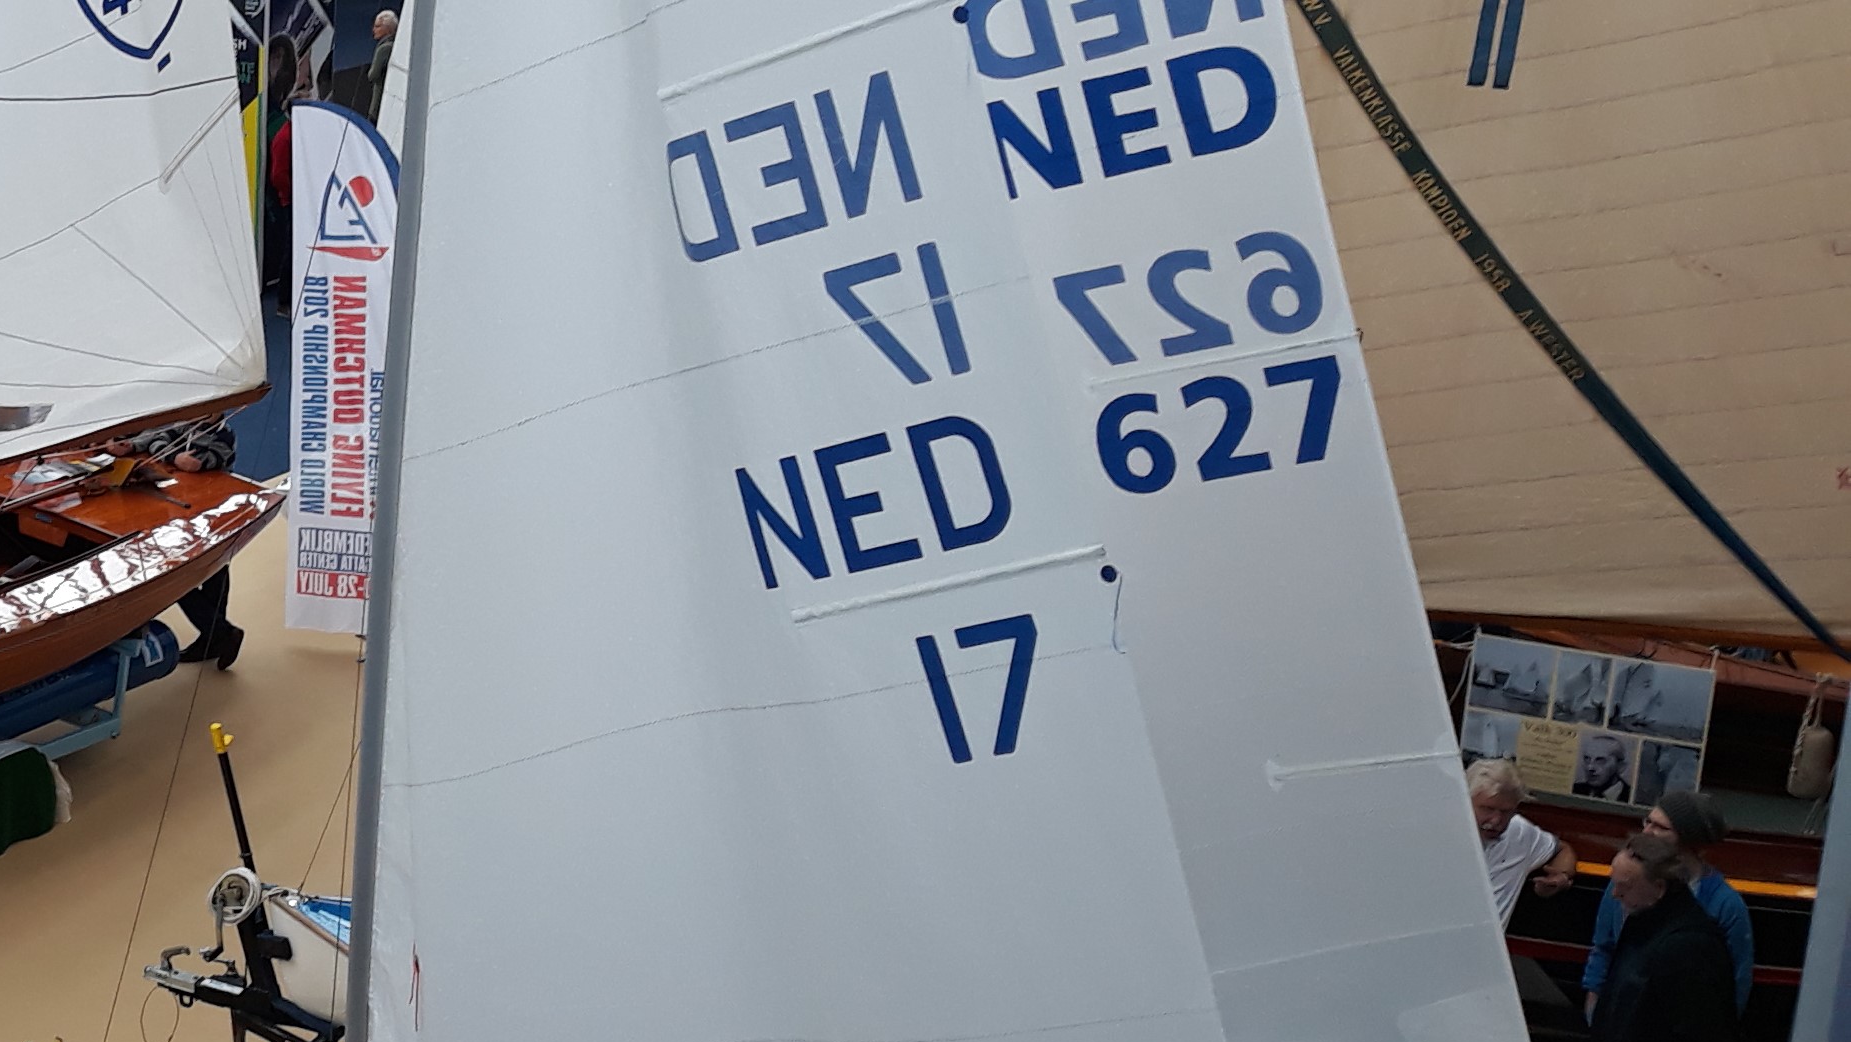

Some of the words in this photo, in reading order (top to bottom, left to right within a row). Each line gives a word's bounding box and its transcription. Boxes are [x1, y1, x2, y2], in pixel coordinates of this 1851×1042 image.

[987, 46, 1277, 200] NED
[1333, 44, 1413, 153] VALKENKLASSE
[1413, 168, 1472, 241] KAMPIOEN
[1096, 355, 1342, 495] 627
[735, 415, 1012, 590] NED
[915, 614, 1038, 764] 17
